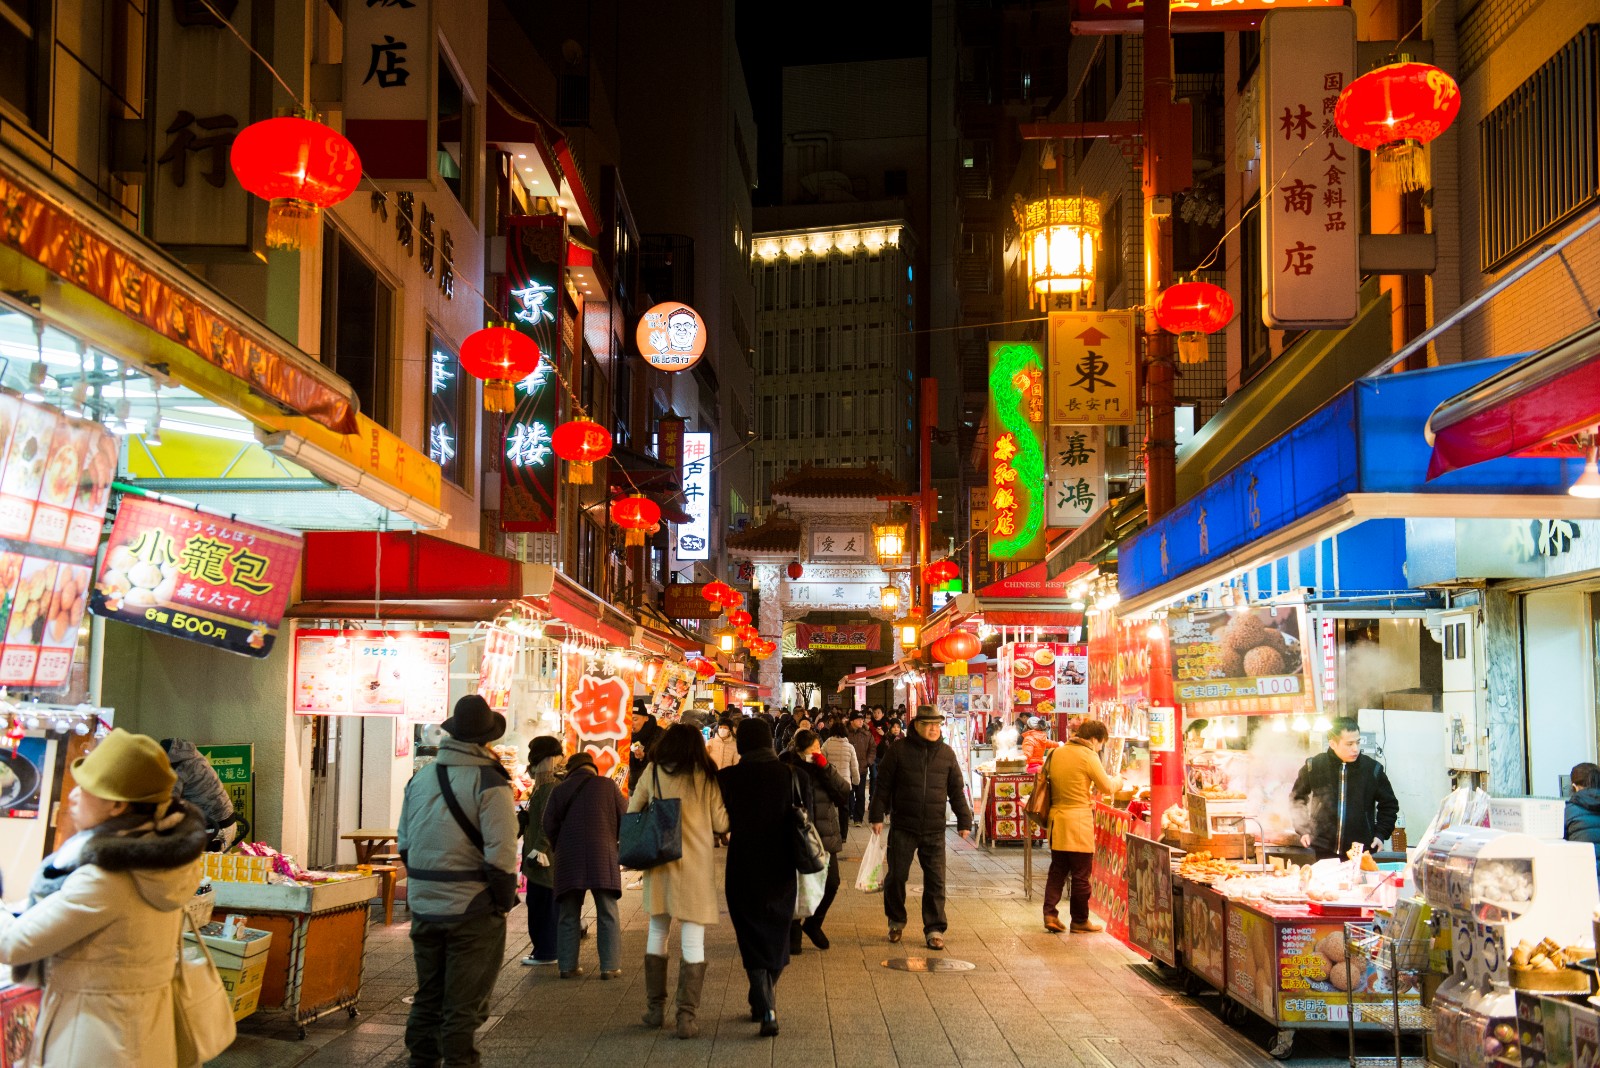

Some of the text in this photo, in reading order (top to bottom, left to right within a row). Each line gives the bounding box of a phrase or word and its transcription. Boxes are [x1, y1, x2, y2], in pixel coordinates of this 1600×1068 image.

[1278, 104, 1317, 276] 林商店
[1069, 351, 1116, 393] 東
[1029, 368, 1044, 423] 中国料理
[1065, 397, 1119, 412] 長安門
[683, 440, 706, 502] 神戸牛
[1057, 431, 1096, 513] 嘉鴻
[129, 526, 273, 595] 小籠包
[145, 608, 228, 639] 6個 500円
[362, 647, 398, 657] タピオカ
[585, 660, 616, 675] 本格
[1181, 684, 1233, 698] ごま団子
[233, 786, 246, 838] 中華
[1284, 999, 1328, 1012] ごま団子
